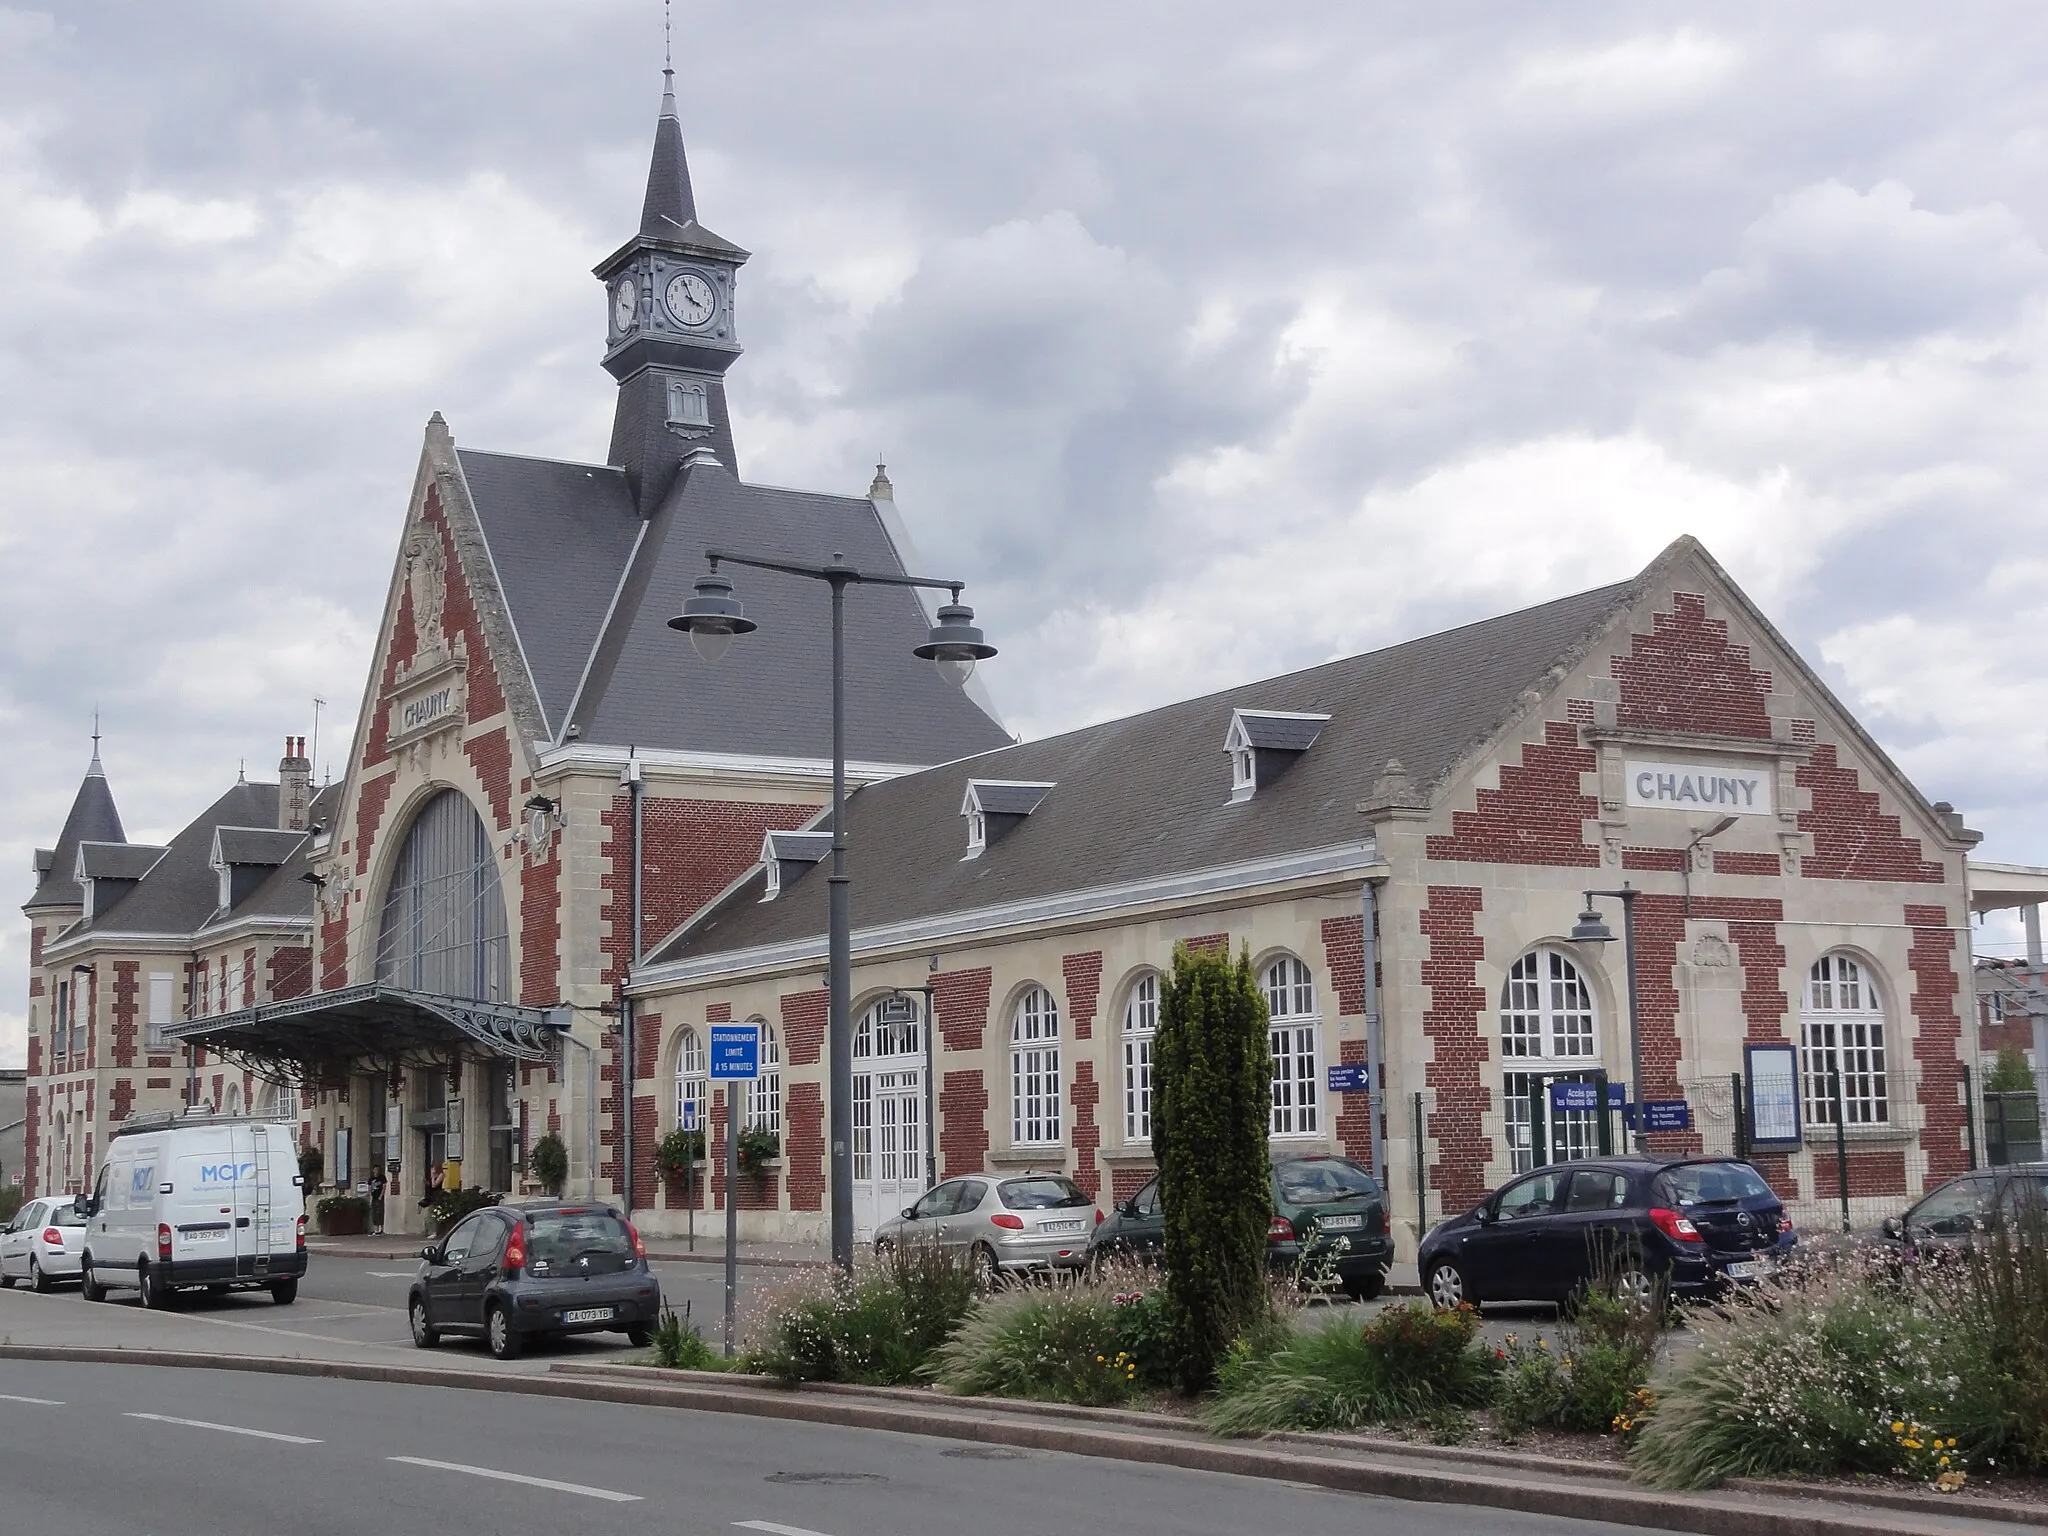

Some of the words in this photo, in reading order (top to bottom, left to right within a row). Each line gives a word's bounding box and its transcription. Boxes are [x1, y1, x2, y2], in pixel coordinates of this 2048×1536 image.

[405, 688, 450, 728] CHAUNY
[1636, 772, 1758, 805] CHAUNY
[712, 1033, 756, 1042] STATIONNEMENT
[725, 1047, 744, 1057] LIMITÉ
[715, 1062, 720, 1071] A
[720, 1062, 728, 1071] 15
[729, 1062, 754, 1071] MINUTES
[1567, 1088, 1585, 1097] Accès
[1556, 1097, 1565, 1106] les
[1566, 1097, 1585, 1106] heures
[1586, 1097, 1594, 1106] de
